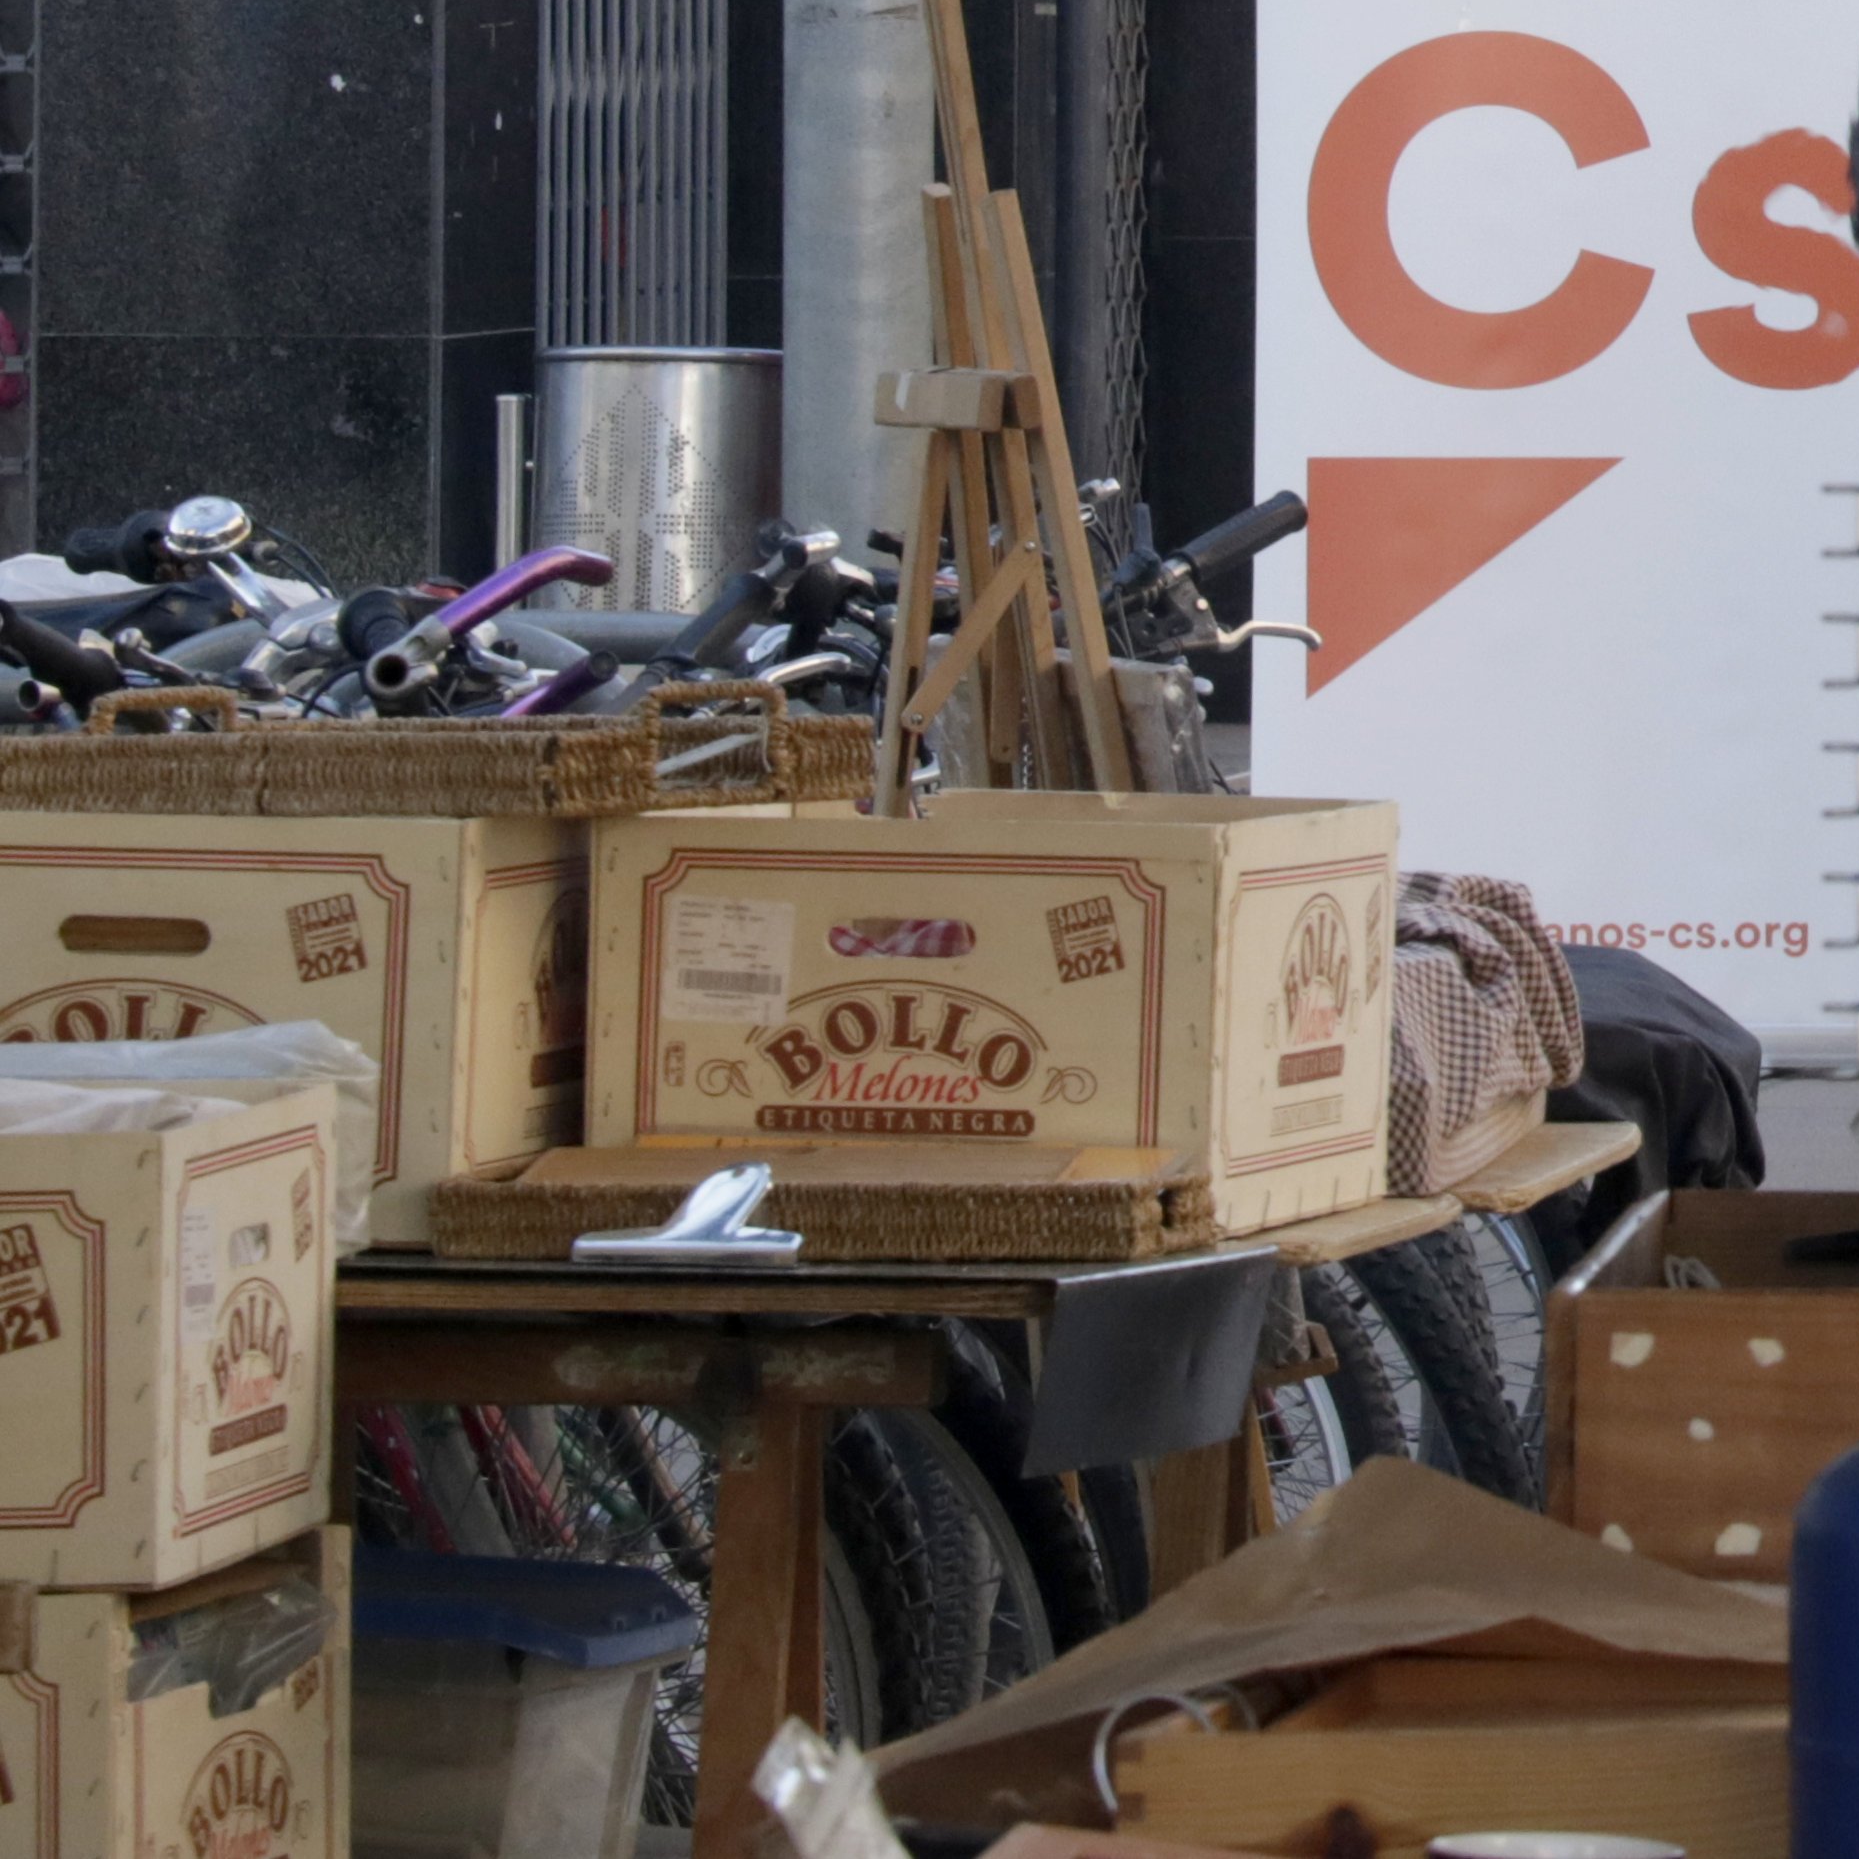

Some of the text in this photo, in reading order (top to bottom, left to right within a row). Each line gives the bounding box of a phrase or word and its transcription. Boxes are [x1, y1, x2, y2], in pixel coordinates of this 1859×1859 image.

[299, 940, 368, 983] 2021
[1058, 942, 1125, 984] 2021
[1284, 911, 1348, 1034] BOLLO
[764, 995, 1032, 1089] BOLLO
[810, 1054, 984, 1104] Melones
[763, 1108, 1028, 1133] ETIQUETA NEGRA
[213, 1294, 288, 1407] BOLLO
